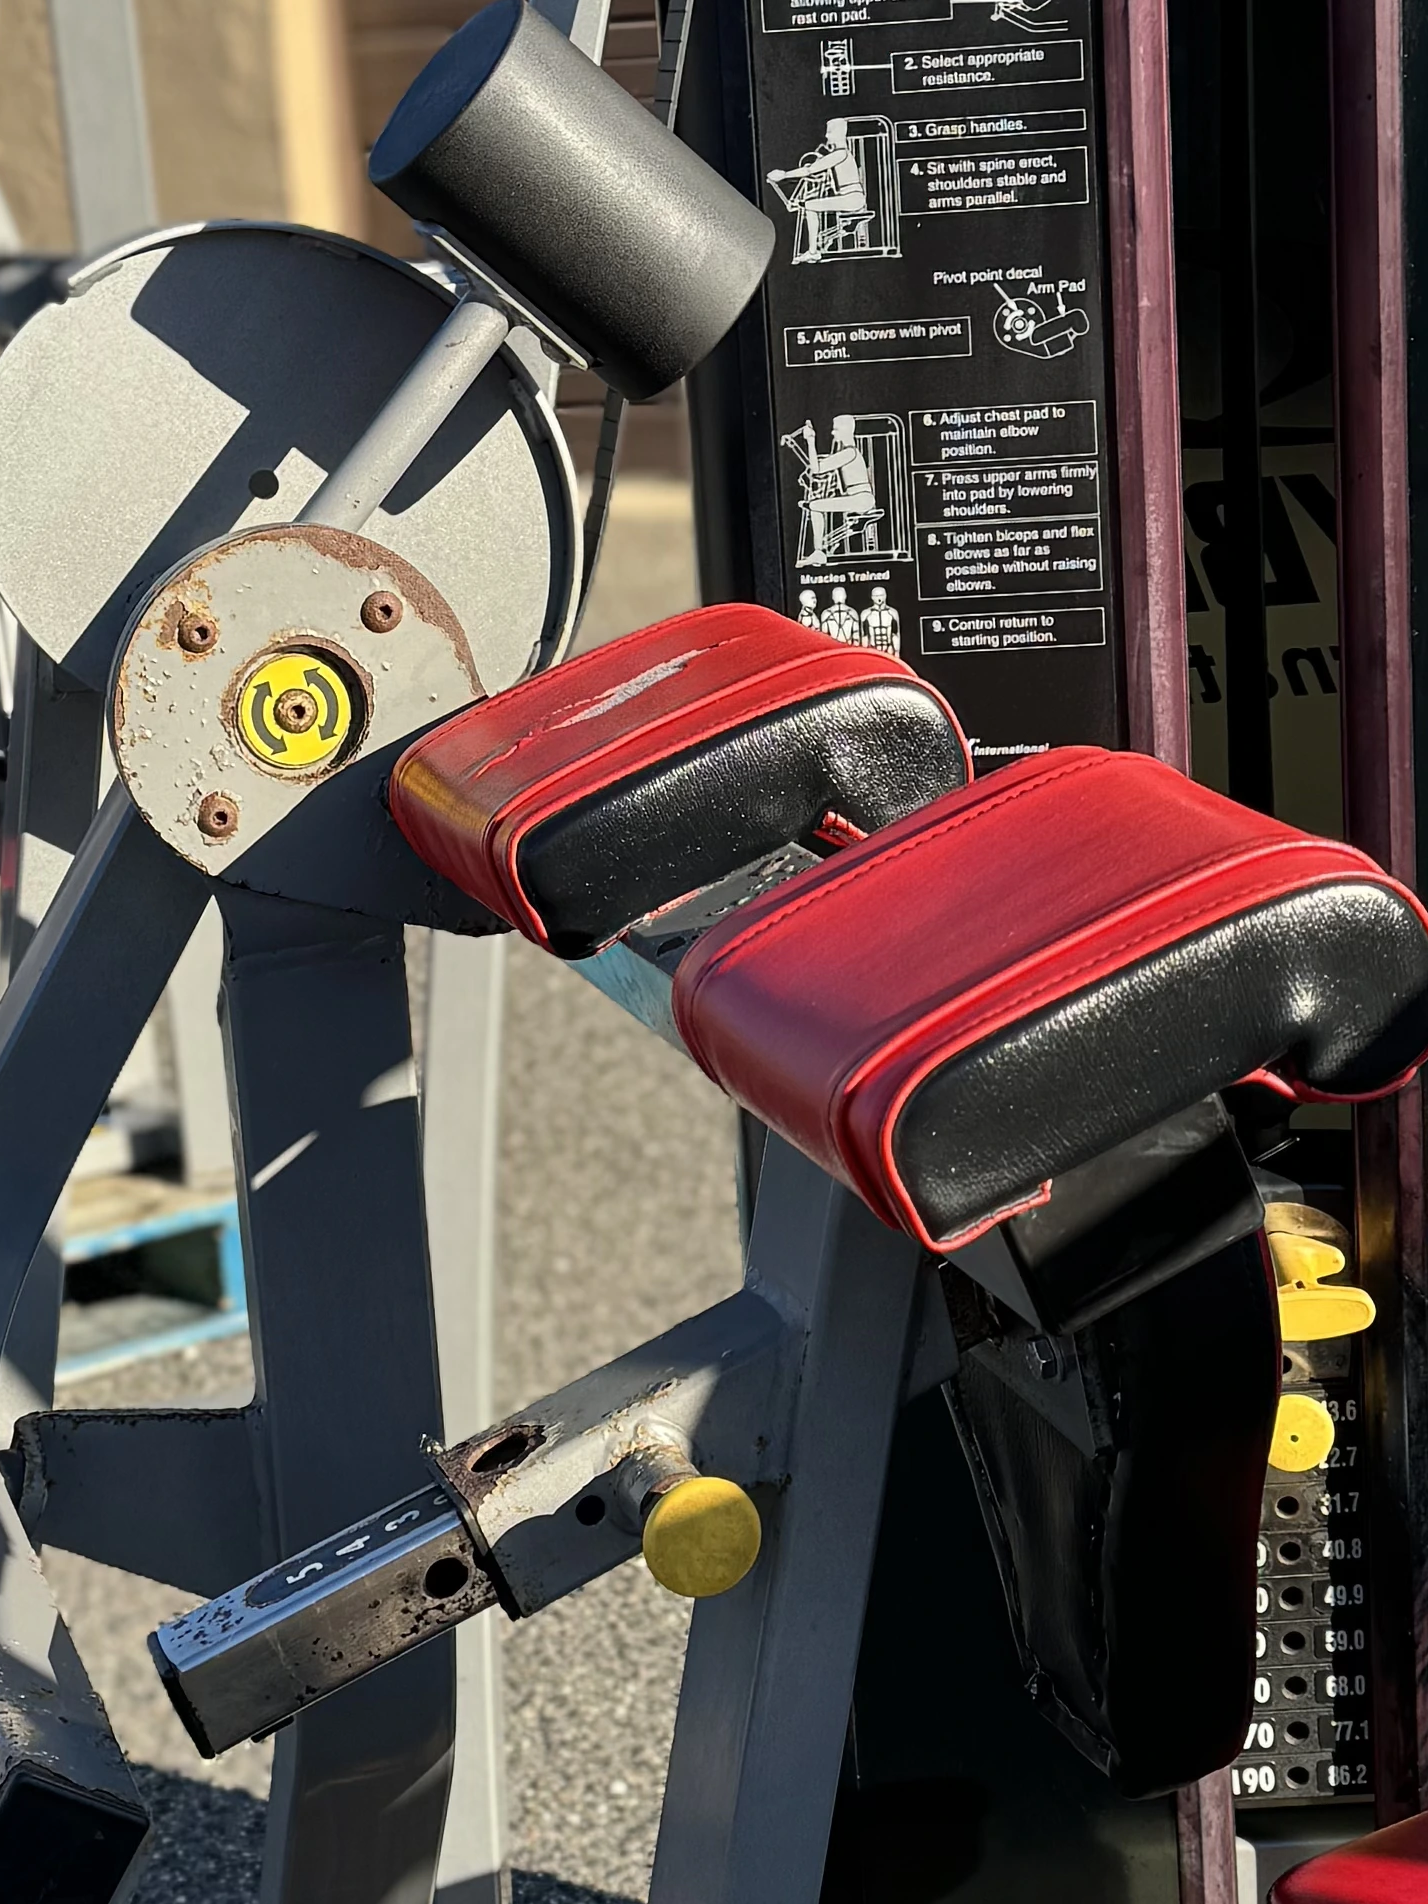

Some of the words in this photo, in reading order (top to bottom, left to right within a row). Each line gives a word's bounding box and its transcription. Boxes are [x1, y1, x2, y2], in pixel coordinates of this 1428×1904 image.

[792, 11, 817, 24] rest
[821, 12, 838, 23] on
[842, 7, 870, 24] pad.
[904, 58, 918, 70] 2.
[922, 54, 964, 69] Select
[967, 48, 1044, 67] appropriate
[923, 71, 995, 87] resistance.
[909, 125, 922, 137] 3.
[926, 122, 966, 140] Grasp
[970, 118, 1027, 134] handles.
[910, 164, 924, 176] 4.
[927, 161, 945, 175] Sit
[948, 159, 975, 174] with
[979, 157, 1016, 174] spine
[928, 175, 993, 192] shoulders
[997, 172, 1037, 187] stable
[1041, 170, 1066, 184] and
[929, 195, 962, 208] arms
[966, 190, 1018, 208] parallel.
[934, 270, 967, 285] Pivot
[970, 268, 1003, 285] point
[1006, 265, 1043, 280] decal
[1027, 282, 1054, 295] Arm
[1059, 278, 1086, 293] Pad
[797, 333, 810, 344] 5.
[813, 329, 846, 345] Align
[850, 326, 896, 341] elbows
[900, 324, 926, 339] with
[930, 323, 962, 340] pivot
[814, 346, 850, 362] point.
[924, 414, 936, 426] 6.
[940, 411, 982, 427] Adjust
[985, 409, 1021, 423] chest
[1024, 408, 1049, 423] pad
[1052, 407, 1066, 418] to
[941, 427, 996, 441] maintain
[1000, 424, 1039, 438] elbow
[942, 443, 996, 459] position.
[926, 474, 938, 486] 7.
[942, 471, 980, 485] Press
[983, 470, 1021, 485] upper
[1024, 467, 1057, 479] arms
[1061, 463, 1096, 481] firmly
[943, 487, 966, 501] into
[970, 486, 995, 502] pad
[998, 485, 1014, 500] by
[1017, 482, 1073, 498] lowering
[944, 502, 1011, 517] shoulders.
[928, 534, 940, 545] 8.
[944, 530, 993, 546] Tighten
[996, 528, 1039, 545] biceps
[1042, 526, 1067, 539] and
[1071, 524, 1095, 538] flex
[945, 548, 990, 561] elbows
[994, 548, 1010, 558] as
[1014, 544, 1034, 557] far
[1037, 545, 1050, 555] as
[801, 573, 846, 585] Muscles
[849, 569, 890, 583] Trained
[946, 563, 999, 578] possible
[1002, 559, 1050, 573] without
[1053, 556, 1096, 572] raising
[947, 577, 996, 592] elbows.
[933, 619, 945, 632] 9.
[949, 616, 996, 631] Control
[1000, 615, 1038, 629] return
[1041, 614, 1054, 626] to
[952, 630, 999, 647] starting
[1003, 628, 1056, 644] position.
[385, 1510, 420, 1532] 3
[336, 1535, 370, 1556] 4
[286, 1562, 323, 1584] 5
[1324, 1584, 1364, 1606] 49.9
[1325, 1630, 1364, 1652] 59.0
[1326, 1675, 1365, 1697] 68.0
[1232, 1766, 1275, 1795] 190
